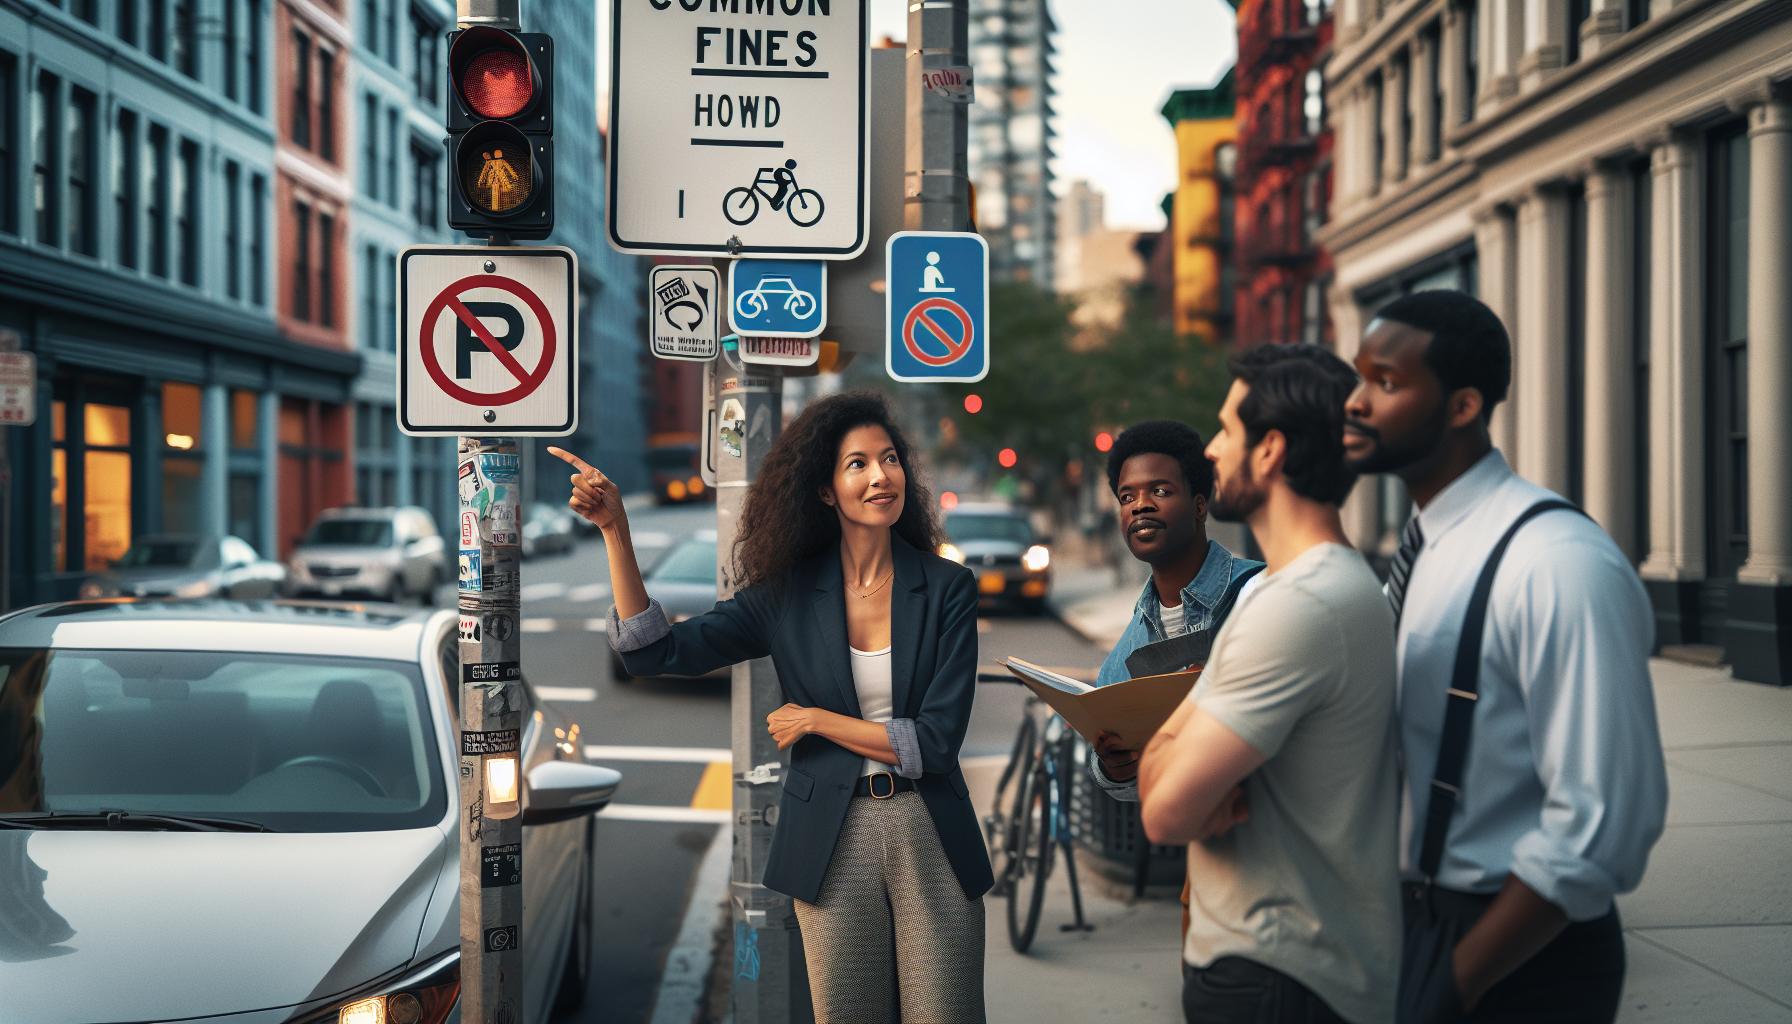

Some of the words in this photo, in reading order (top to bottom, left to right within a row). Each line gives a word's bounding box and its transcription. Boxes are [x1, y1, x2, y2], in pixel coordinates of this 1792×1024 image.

[697, 27, 817, 67] FINES
[695, 94, 780, 128] HOWD
[456, 301, 525, 379] P
